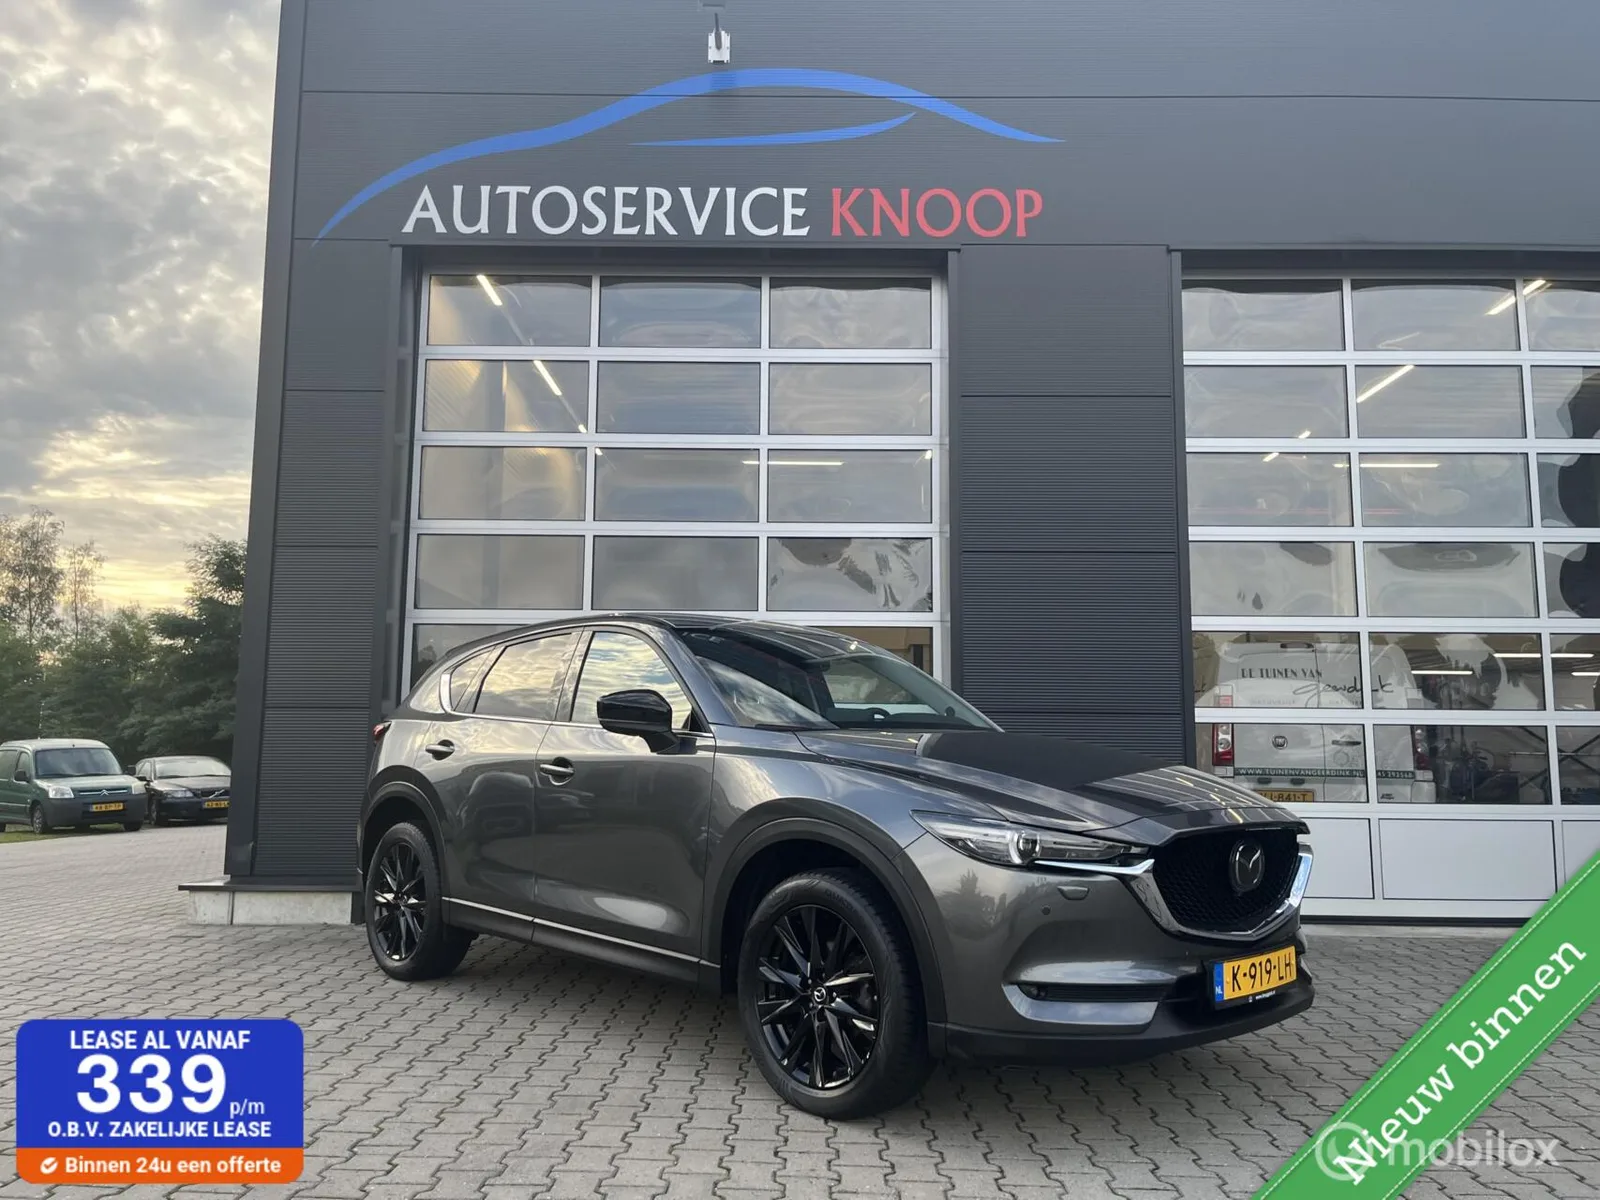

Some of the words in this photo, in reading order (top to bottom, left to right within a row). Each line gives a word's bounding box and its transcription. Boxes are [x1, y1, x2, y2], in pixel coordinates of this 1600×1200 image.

[401, 184, 810, 237] AUTOSERVICE
[830, 187, 1044, 238] KNOOP
[1241, 667, 1254, 679] DE
[1259, 667, 1298, 679] TUINEN
[1301, 667, 1323, 679] VAN
[1231, 952, 1292, 993] K-919-LH
[1215, 984, 1223, 995] NL
